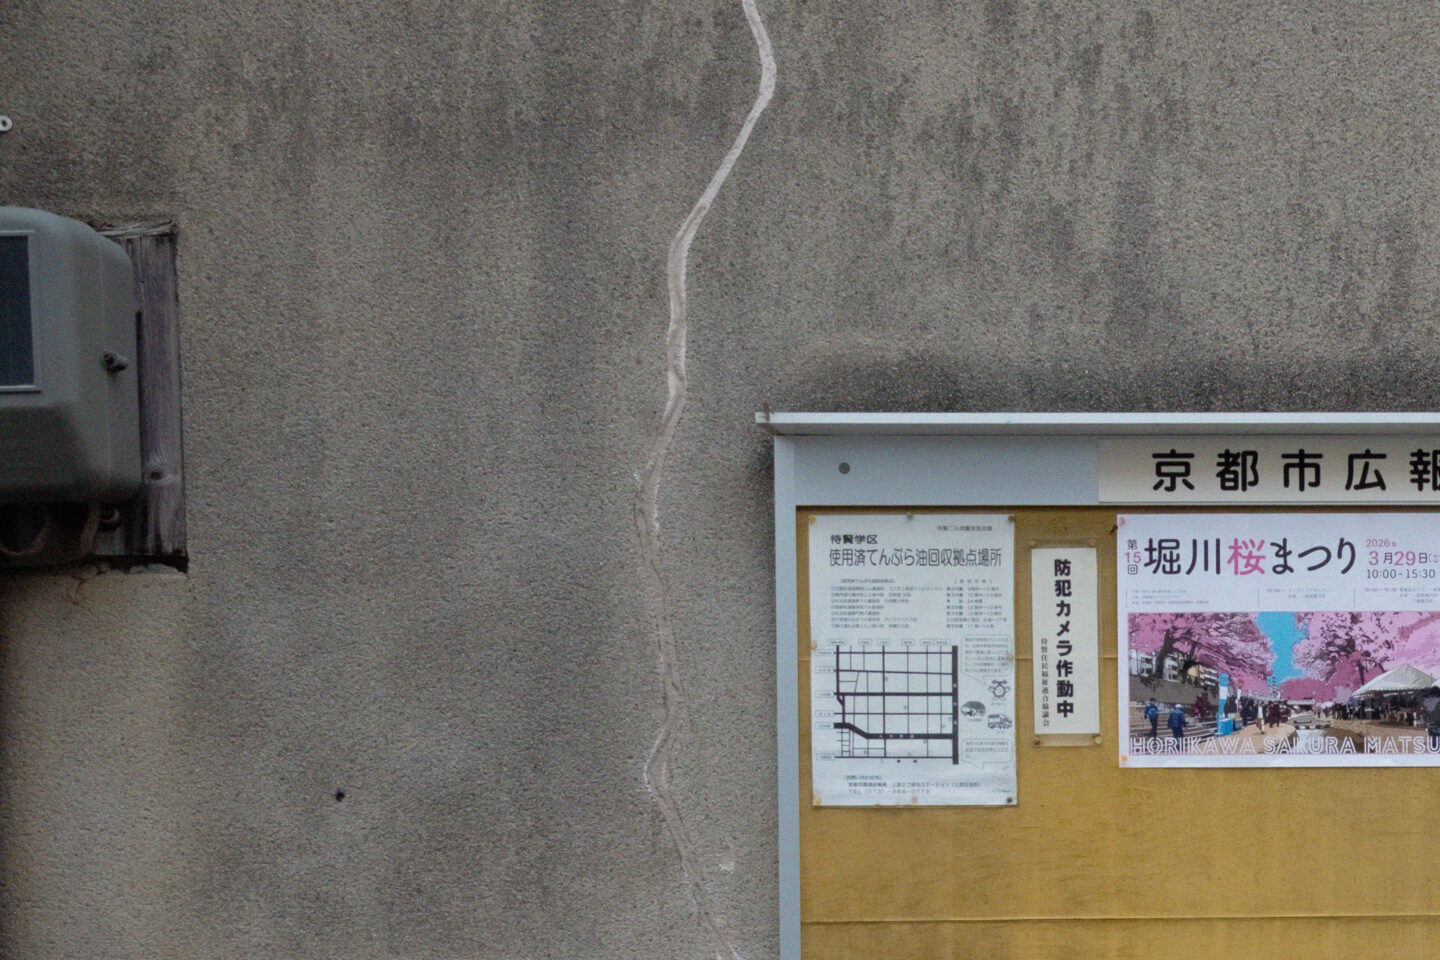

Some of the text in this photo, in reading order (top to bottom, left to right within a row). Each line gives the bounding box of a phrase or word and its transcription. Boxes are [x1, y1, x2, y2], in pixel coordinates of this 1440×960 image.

[830, 534, 878, 545] 待賢学区
[829, 548, 1002, 568] 使用済てんぷら油回収拠点場所
[1143, 538, 1356, 575] 堀川桜まつり
[1054, 559, 1074, 718] 防犯カメラ作動中
[1130, 736, 1254, 755] HORIKAWA
[1262, 736, 1356, 755] SAKURA
